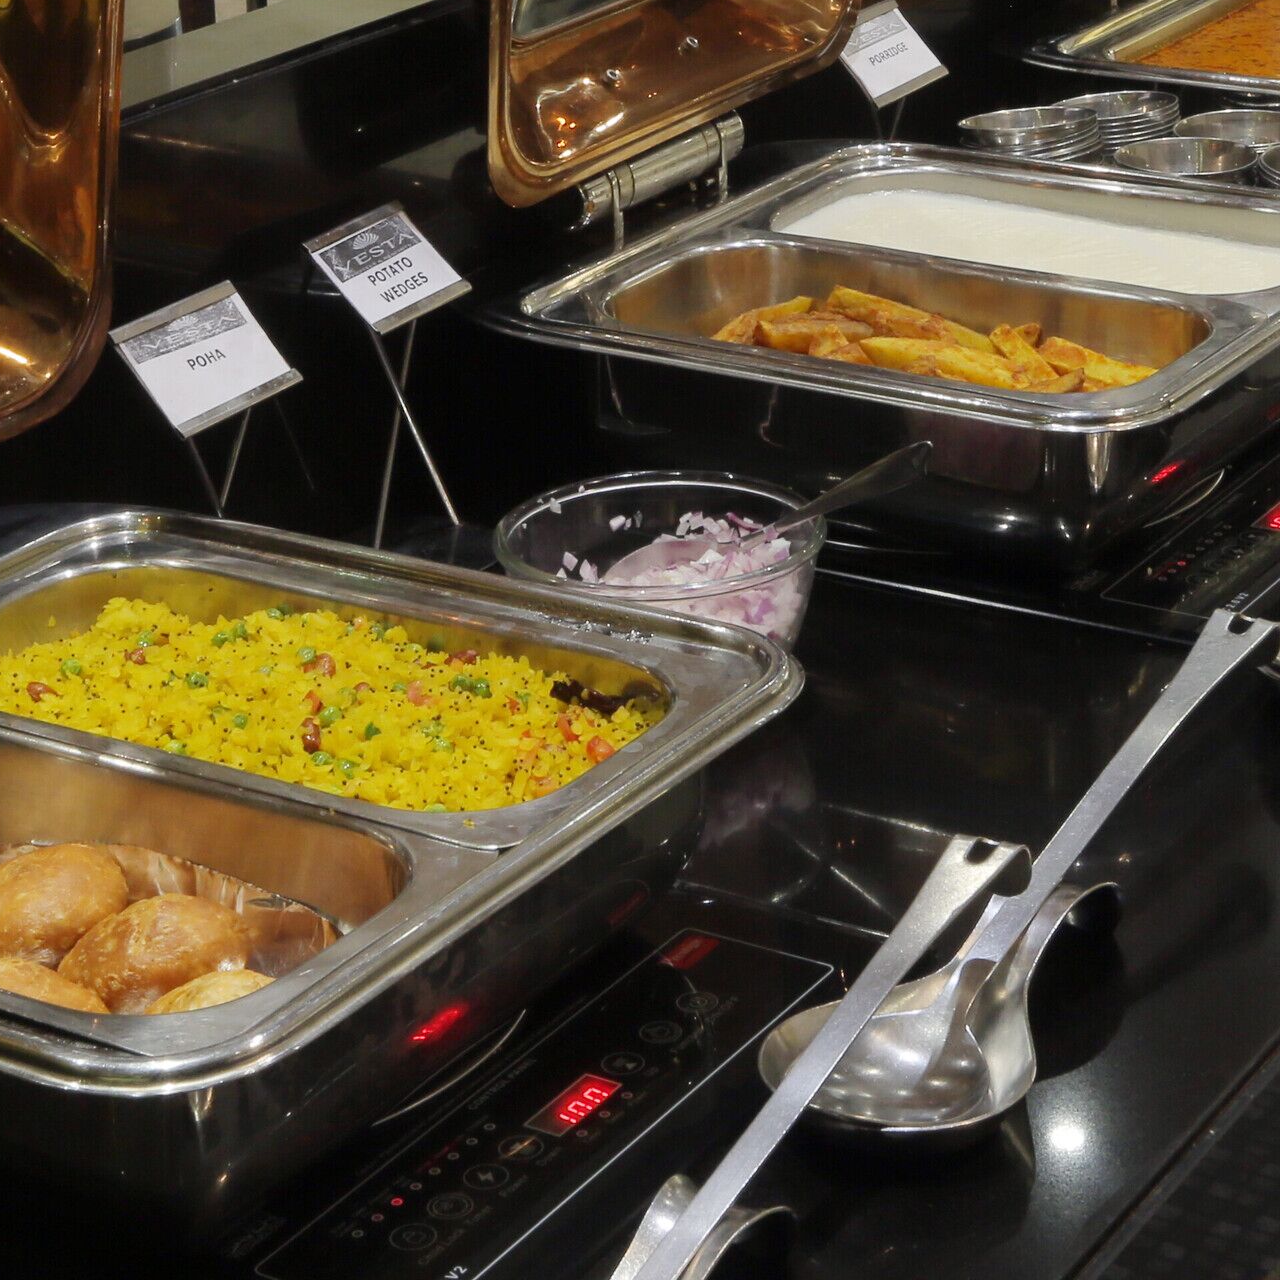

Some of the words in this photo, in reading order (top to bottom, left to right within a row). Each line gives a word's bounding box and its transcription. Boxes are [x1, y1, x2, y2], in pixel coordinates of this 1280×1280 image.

[849, 22, 900, 49] VESTA
[868, 41, 908, 66] PORRIDGE
[332, 232, 415, 272] VESTA
[368, 256, 413, 287] POTATO
[380, 271, 429, 304] WEDGES
[142, 315, 239, 352] VESTA
[187, 348, 227, 370] POHA
[444, 1266, 468, 1279] V2
